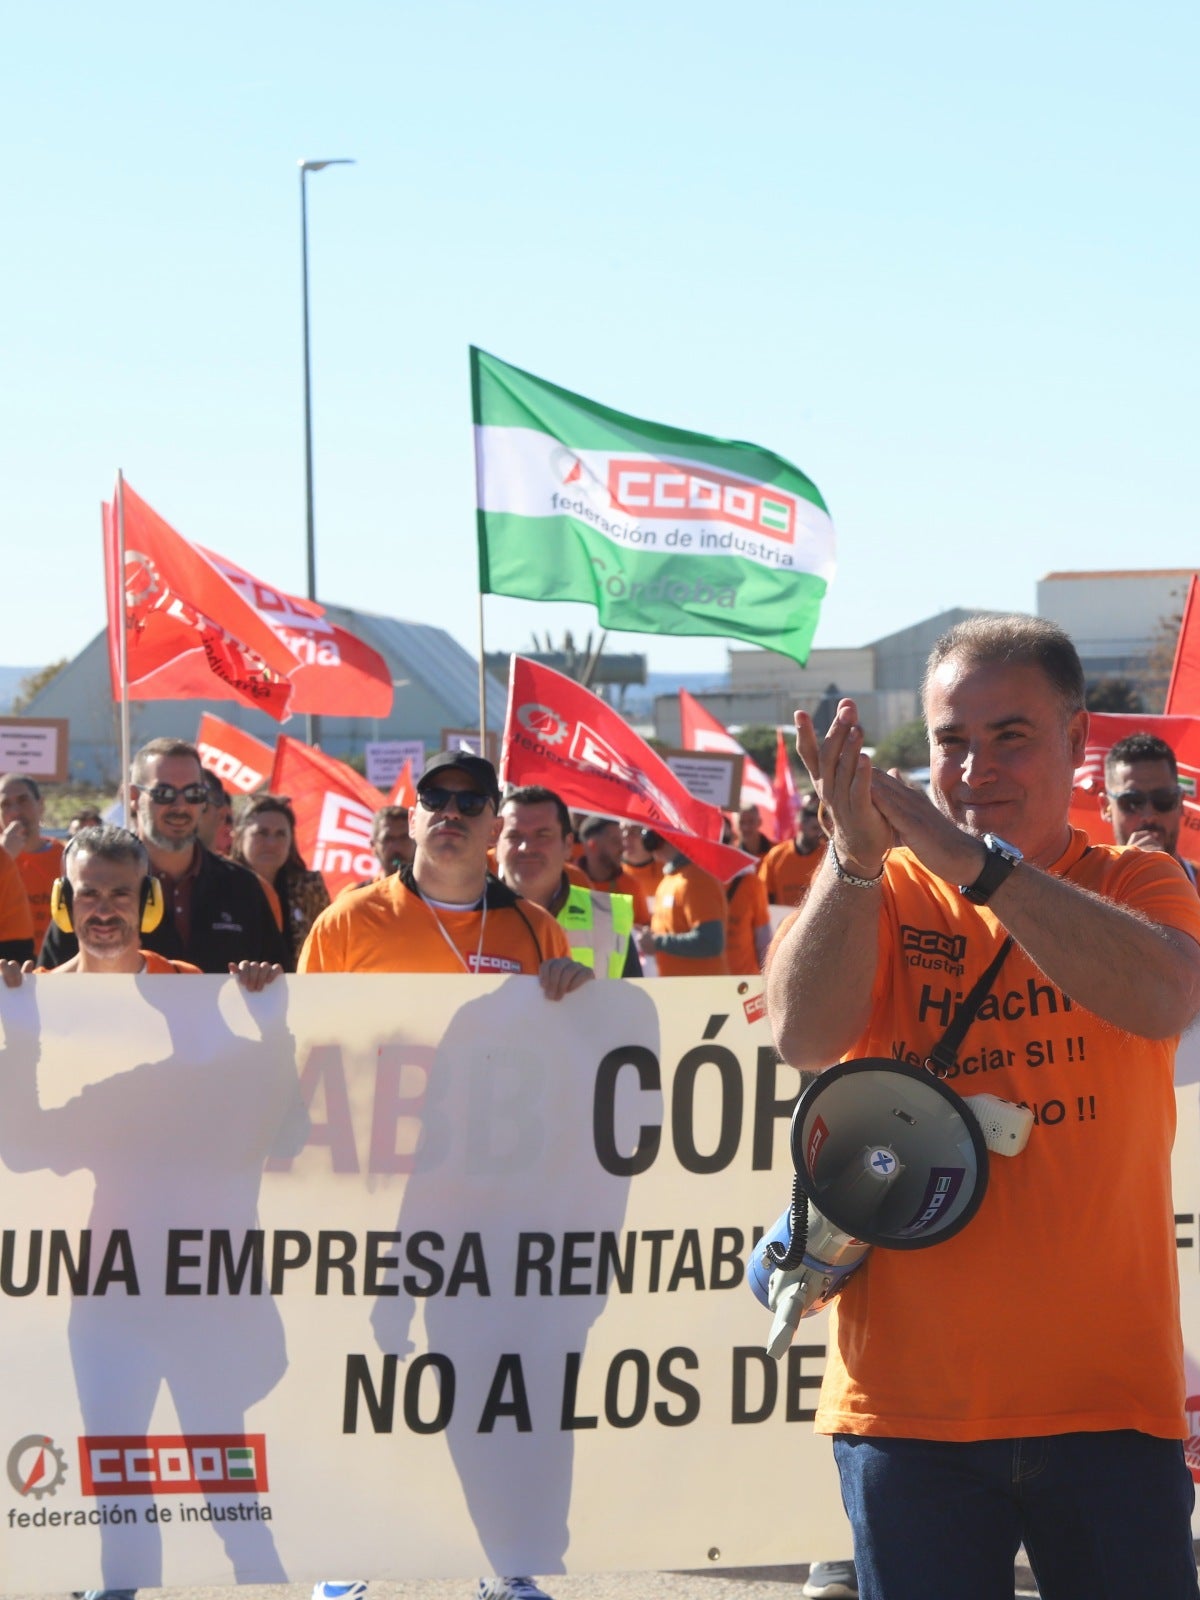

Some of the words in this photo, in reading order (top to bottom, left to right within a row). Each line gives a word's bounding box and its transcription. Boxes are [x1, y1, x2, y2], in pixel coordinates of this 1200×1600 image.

[550, 490, 657, 545] federación
[665, 528, 693, 547] de
[700, 529, 794, 566] industria
[1025, 1040, 1055, 1067] SI
[0, 1229, 141, 1297] UNA
[165, 1229, 492, 1298] EMPRESA
[342, 1353, 456, 1435] NO
[477, 1353, 534, 1434] A
[560, 1346, 702, 1431] LOS
[90, 1449, 224, 1483] CCOO
[8, 1505, 137, 1528] federación
[145, 1502, 172, 1523] de
[180, 1501, 273, 1522] industria
